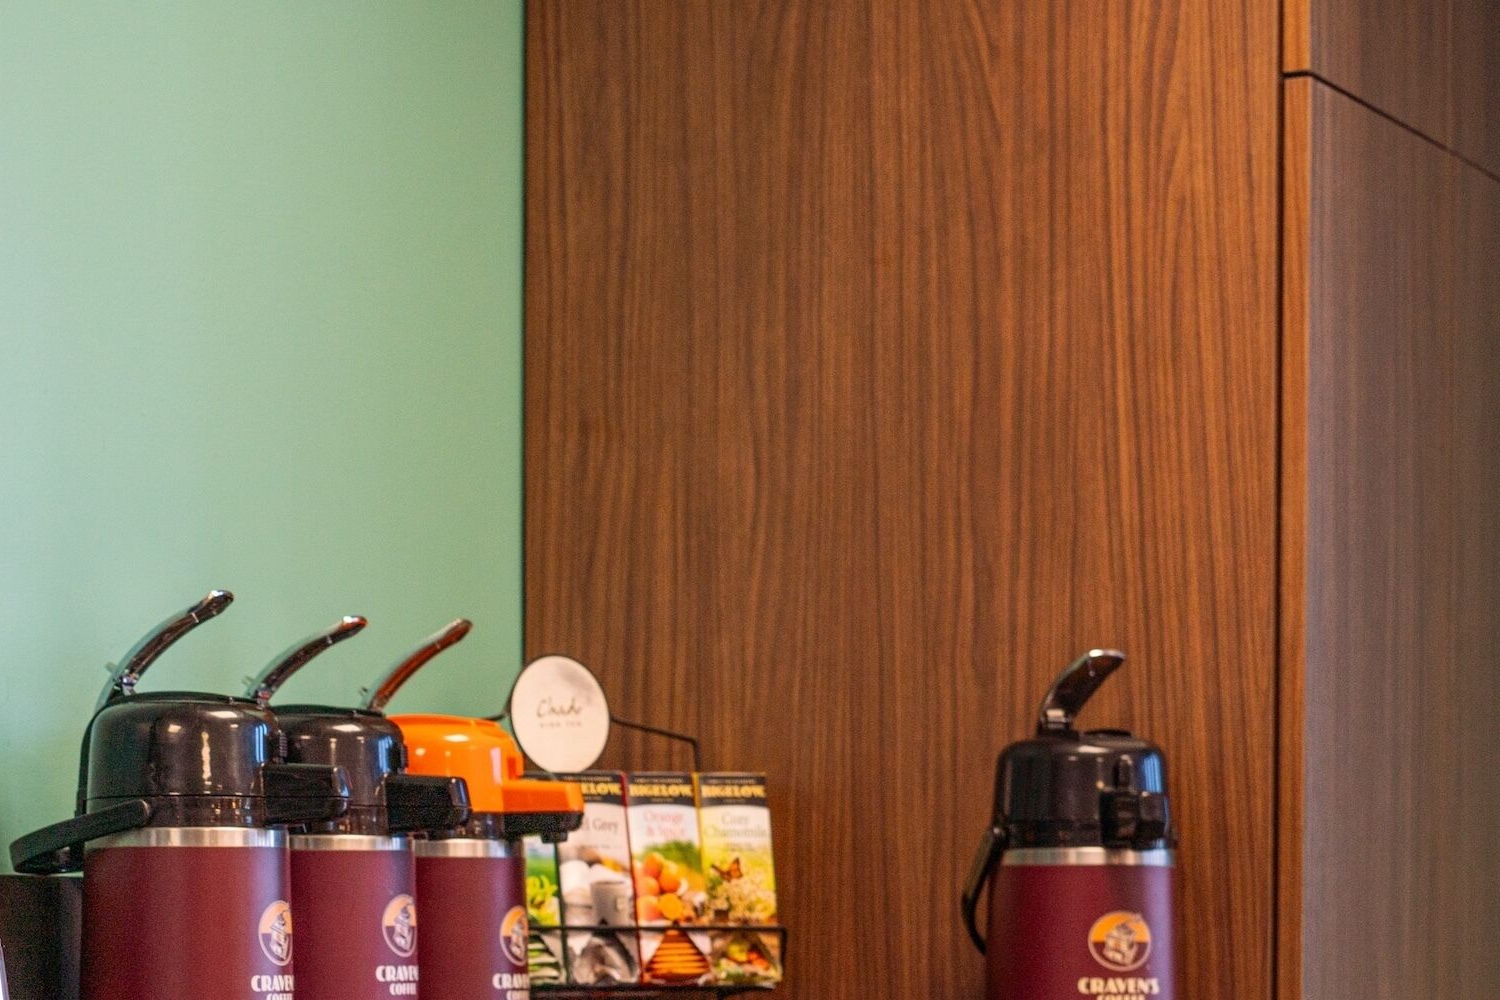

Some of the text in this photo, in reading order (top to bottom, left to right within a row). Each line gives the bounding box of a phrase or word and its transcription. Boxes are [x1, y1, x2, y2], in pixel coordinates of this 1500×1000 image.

[581, 783, 622, 796] ELOW
[629, 784, 693, 798] BIGELOW
[701, 785, 766, 799] BIGELOW
[1077, 977, 1160, 994] CRAVENS
